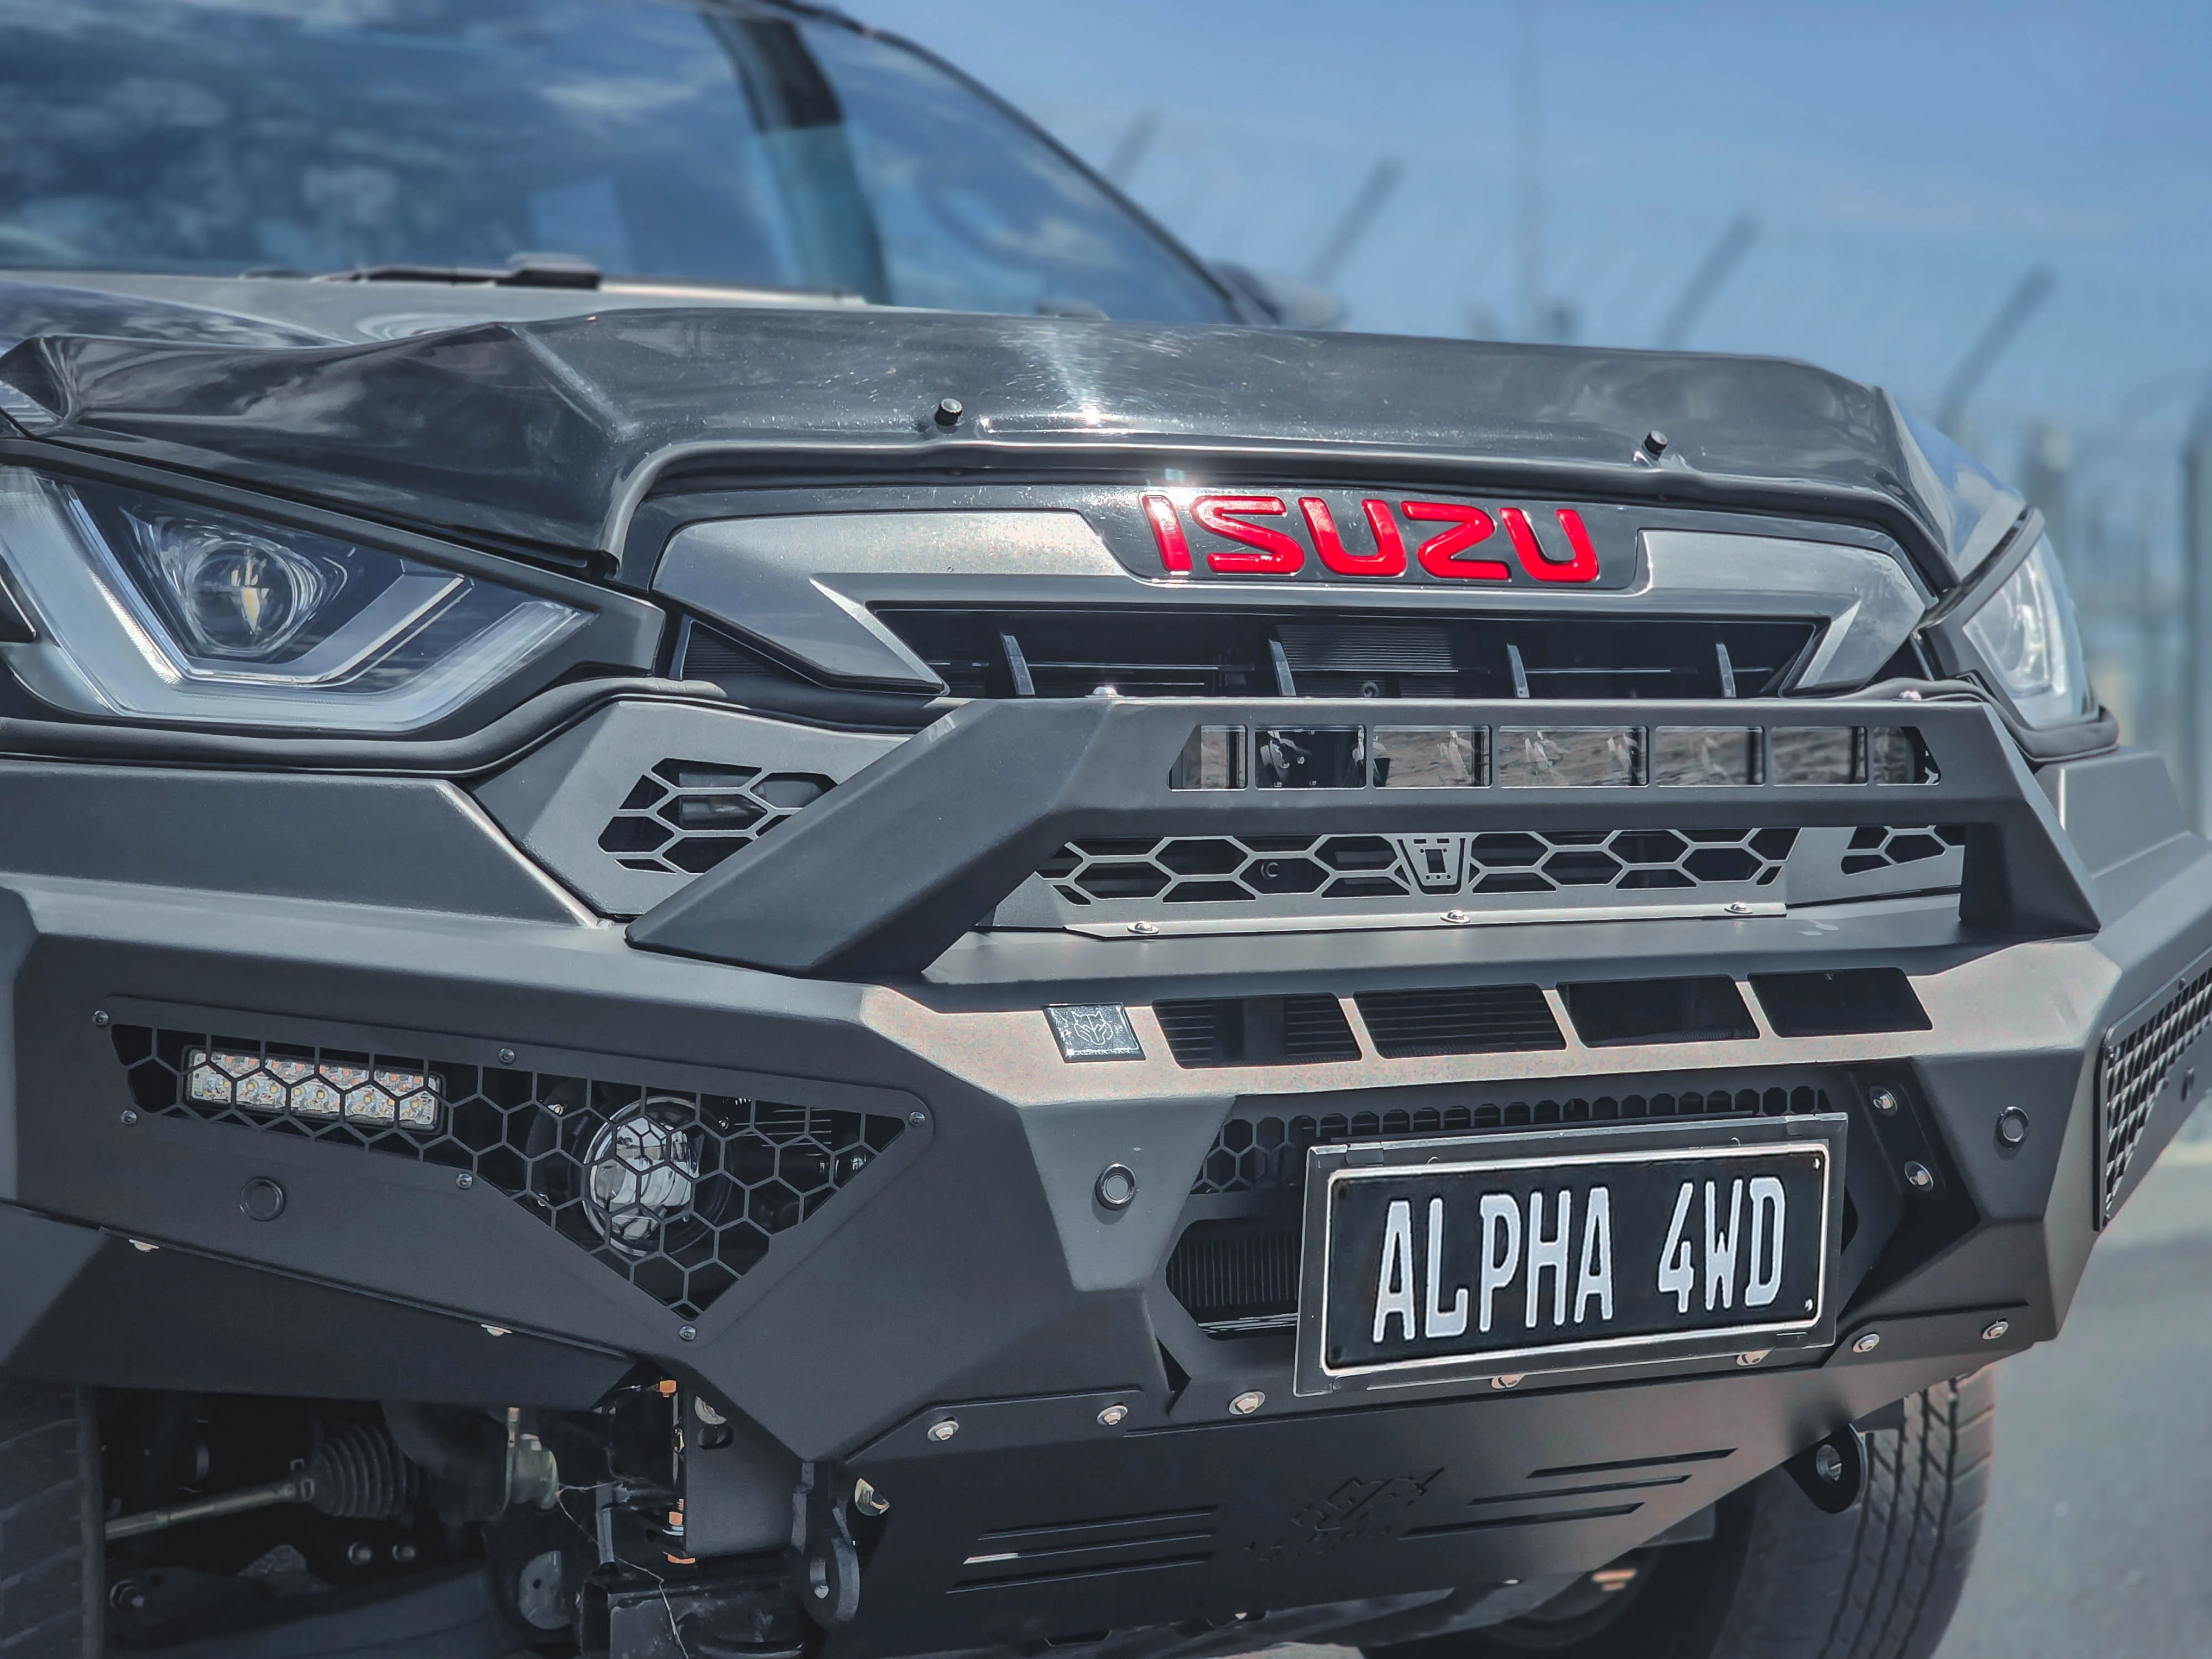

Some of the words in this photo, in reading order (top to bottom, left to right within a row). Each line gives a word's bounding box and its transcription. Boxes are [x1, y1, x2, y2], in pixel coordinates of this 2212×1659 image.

[1141, 495, 1599, 582] ISUZU
[1373, 1186, 1614, 1344] ALPHA
[1658, 1176, 1786, 1314] 4WD
